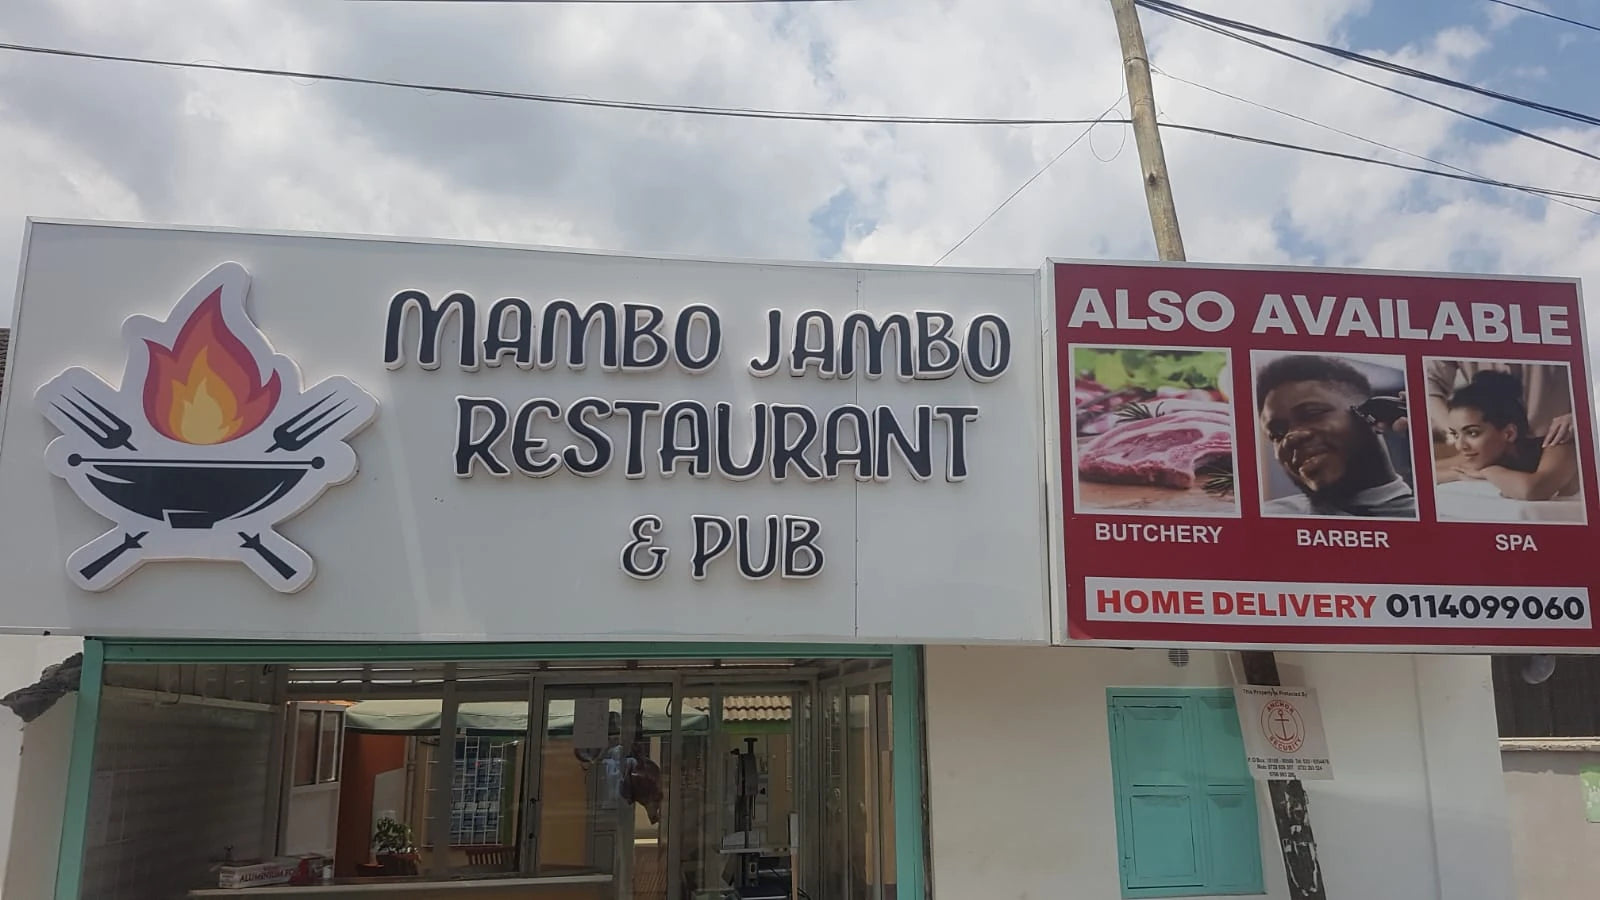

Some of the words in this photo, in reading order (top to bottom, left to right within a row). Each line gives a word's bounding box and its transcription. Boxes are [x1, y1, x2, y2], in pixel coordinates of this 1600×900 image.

[1067, 287, 1236, 332] ALSO
[1251, 293, 1572, 346] AVAILABLE
[383, 289, 721, 371] MAMBO
[749, 308, 1011, 383] JAMBO
[453, 396, 979, 482] RESTAURANT
[1095, 522, 1223, 544] BUTCHERY
[1296, 529, 1390, 548] BARBER
[1495, 534, 1538, 552] SPA
[620, 514, 670, 580] &
[690, 514, 826, 581] PUB
[1096, 589, 1205, 615] HOME
[1212, 591, 1377, 619] DELIVERY
[1386, 593, 1585, 621] 0114099060
[1253, 689, 1273, 697] Property
[1266, 702, 1295, 714] ANCHOR
[1269, 735, 1302, 751] SECURITY
[240, 869, 284, 881] ALUMINIUM
